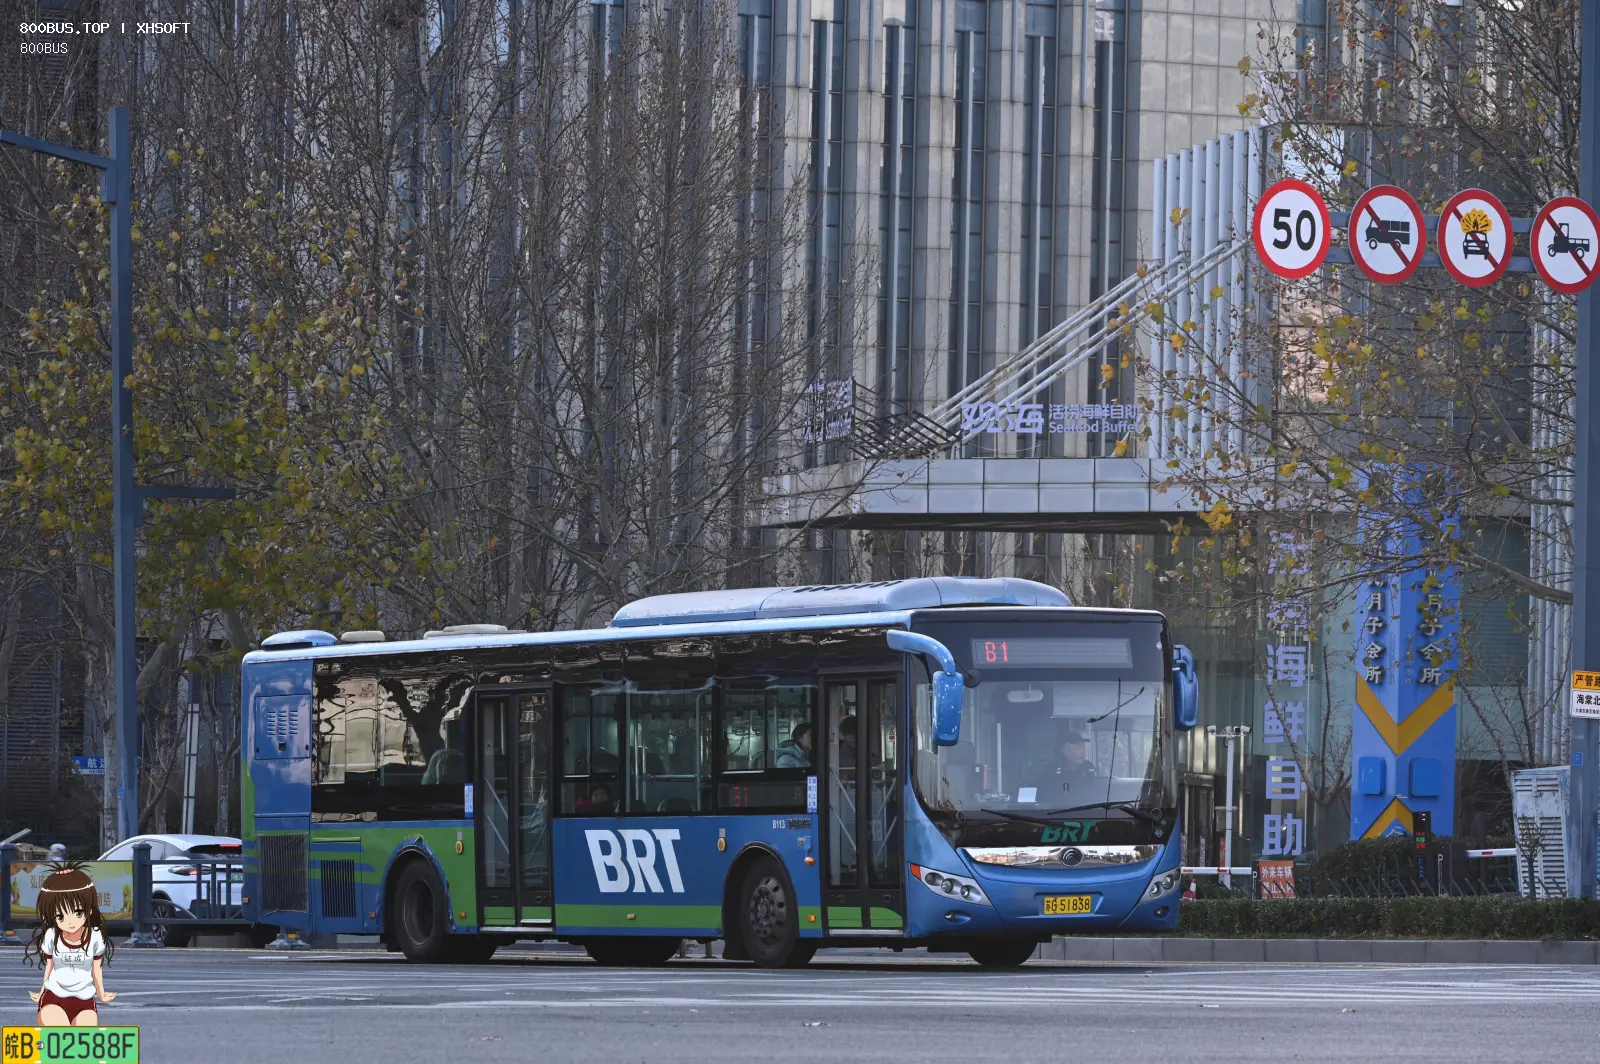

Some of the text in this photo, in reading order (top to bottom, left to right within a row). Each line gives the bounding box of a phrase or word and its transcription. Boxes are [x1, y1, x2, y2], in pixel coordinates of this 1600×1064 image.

[1272, 208, 1316, 251] 50
[961, 402, 1044, 434] 观海
[1049, 420, 1099, 433] Seafood
[985, 641, 1008, 663] B1
[772, 819, 786, 829] B113
[1041, 821, 1096, 843] BRT
[584, 828, 685, 893] BRT
[1261, 865, 1293, 878] 外来车辆
